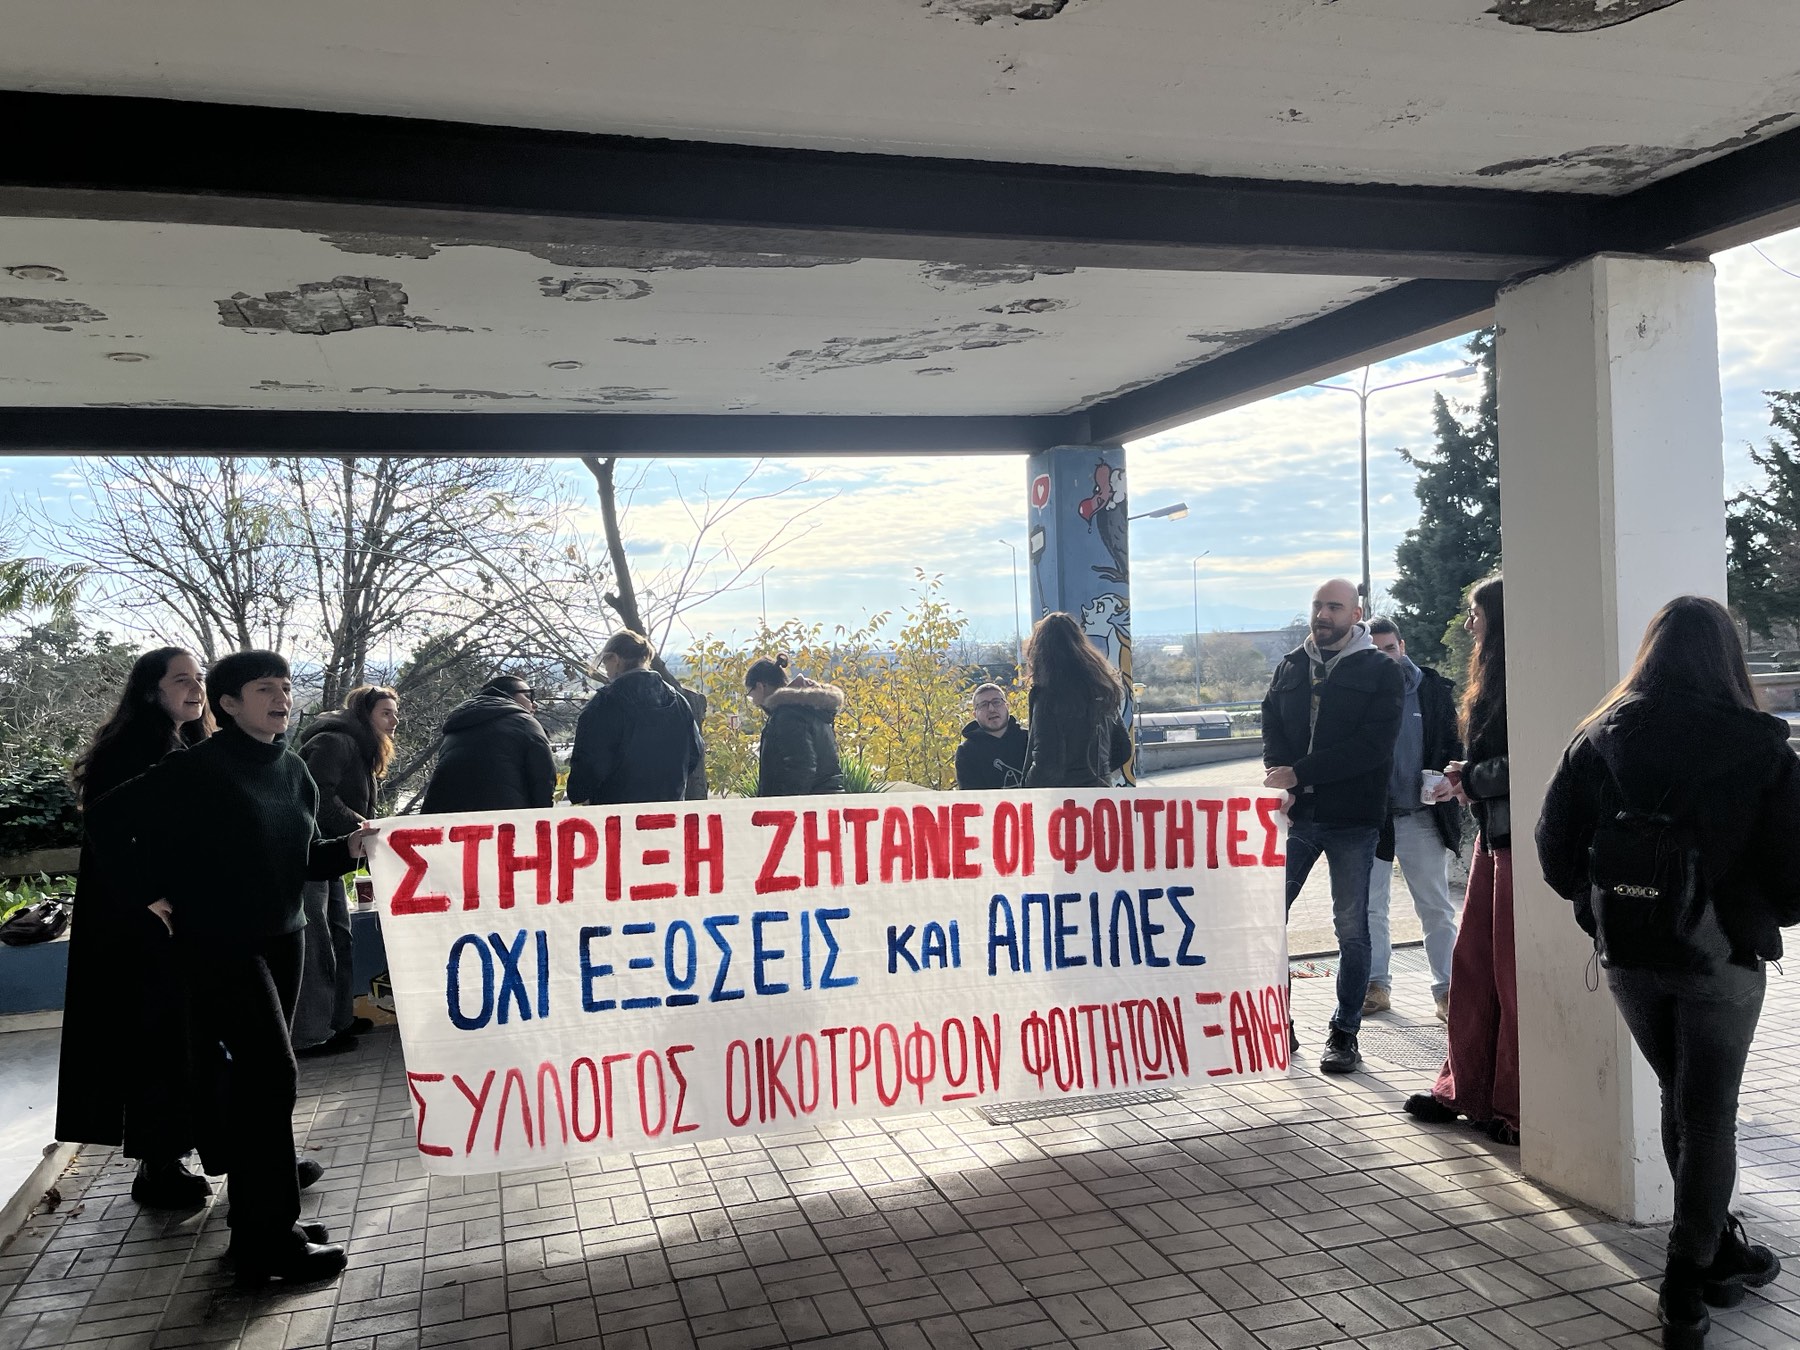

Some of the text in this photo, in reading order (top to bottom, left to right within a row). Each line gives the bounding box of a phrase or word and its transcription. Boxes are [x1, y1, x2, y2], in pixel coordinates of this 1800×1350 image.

[387, 797, 1286, 917] ΣΤΗΡΙΞΗ ΖΗΤΑΝΕ ΟΙ ΦΟΙΤΗΤΕΣ
[446, 886, 1207, 1031] ΟΧΙ ΕΞΩΣΕΙΣ ΚΑΙ ΑΠΕΙΛΕΣ
[406, 1044, 700, 1158] ΣΥΛΛΟΓΟΣ
[725, 1013, 1001, 1128] ΟΙΚΟΤΡΟΦΩΝ
[1020, 996, 1190, 1092] ΦΟΙΤΗΤΩΝ
